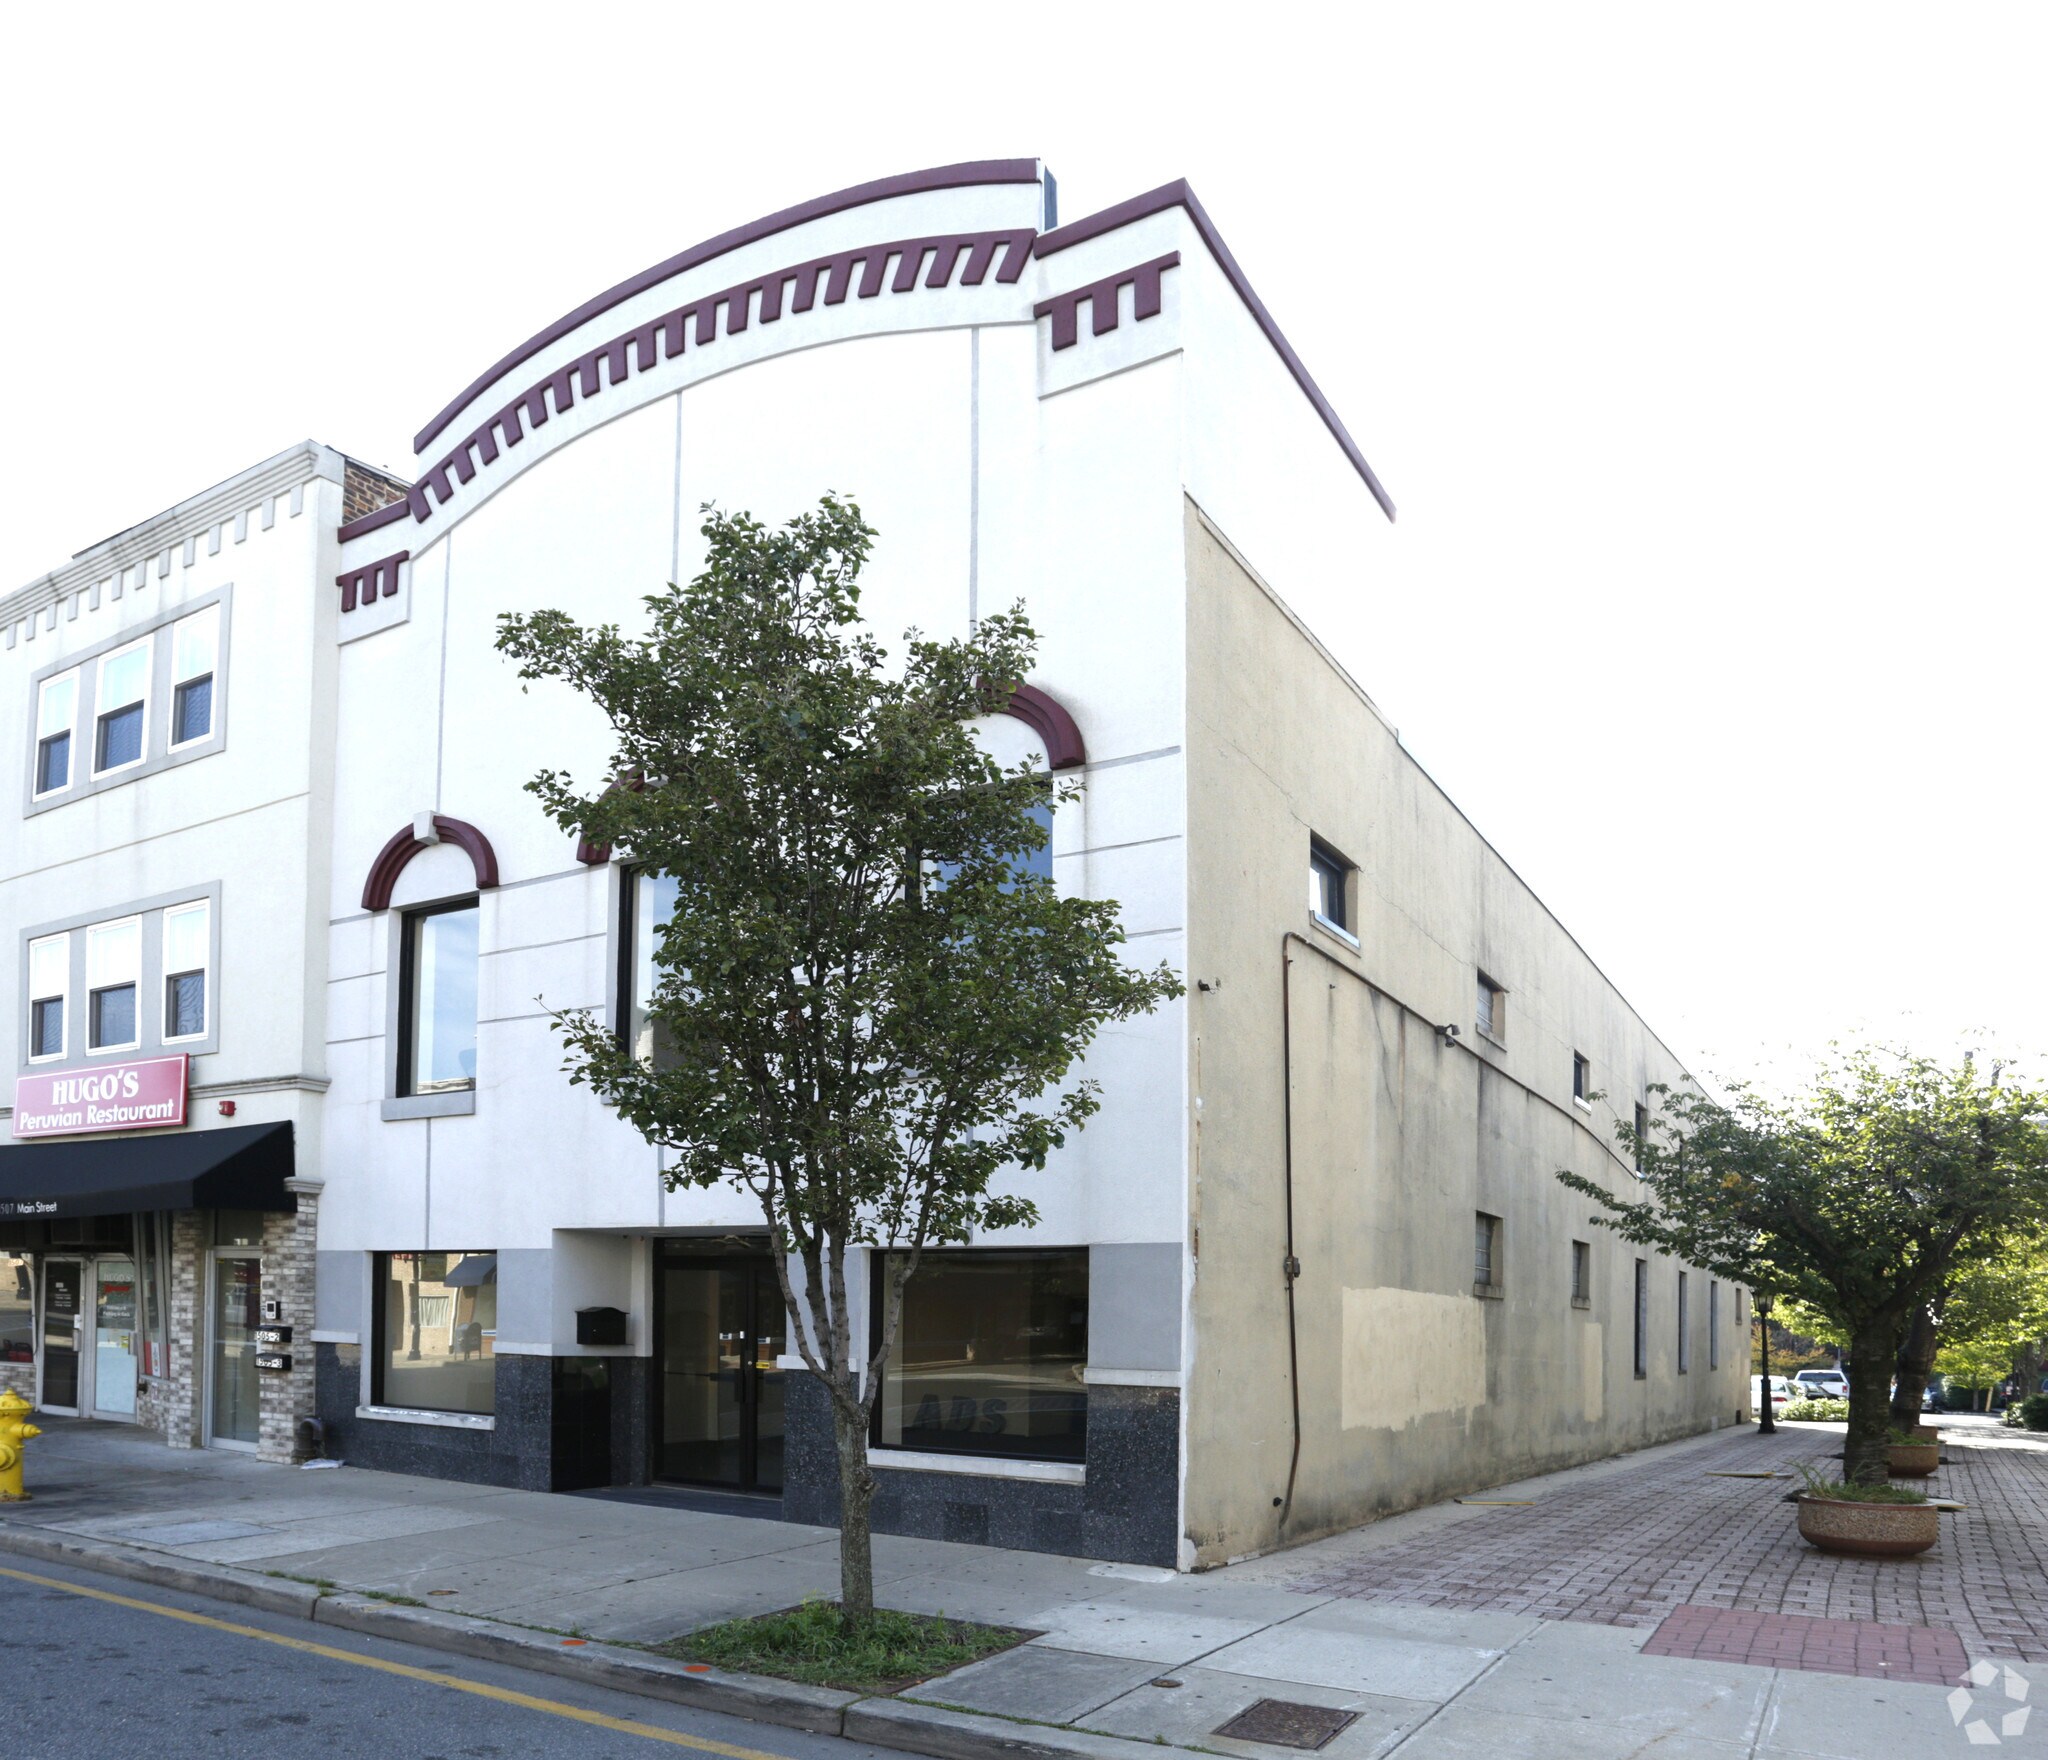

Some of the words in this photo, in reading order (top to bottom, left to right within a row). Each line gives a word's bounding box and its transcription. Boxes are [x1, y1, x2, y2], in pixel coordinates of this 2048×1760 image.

[52, 1069, 139, 1105] HUGO'S
[20, 1107, 82, 1130] Peruvian
[87, 1099, 174, 1124] Restaurant
[16, 1202, 35, 1214] Main
[35, 1201, 58, 1213] Street
